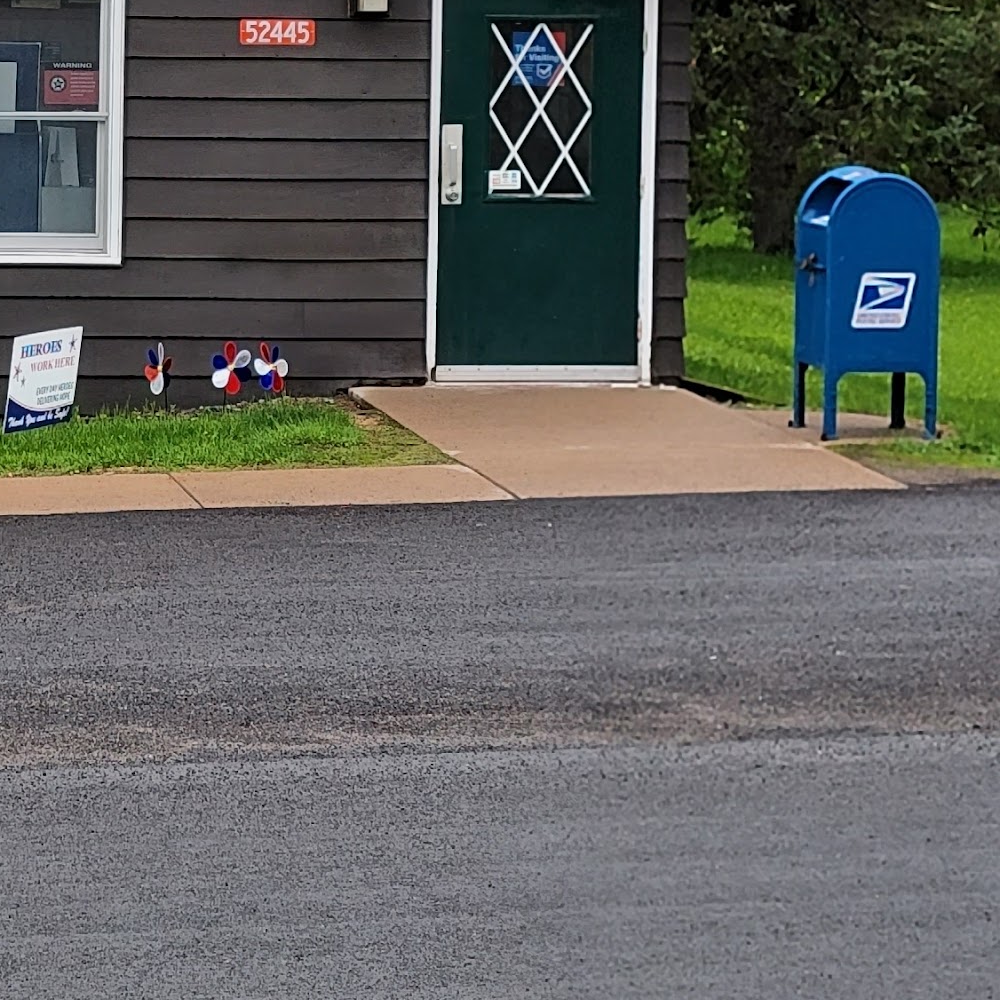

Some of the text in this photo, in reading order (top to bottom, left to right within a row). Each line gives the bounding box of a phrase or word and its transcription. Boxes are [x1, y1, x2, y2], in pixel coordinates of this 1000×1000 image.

[245, 20, 310, 43] 52445
[529, 53, 559, 63] Visiting
[20, 339, 63, 359] HEROES
[30, 356, 75, 373] WORK HERE
